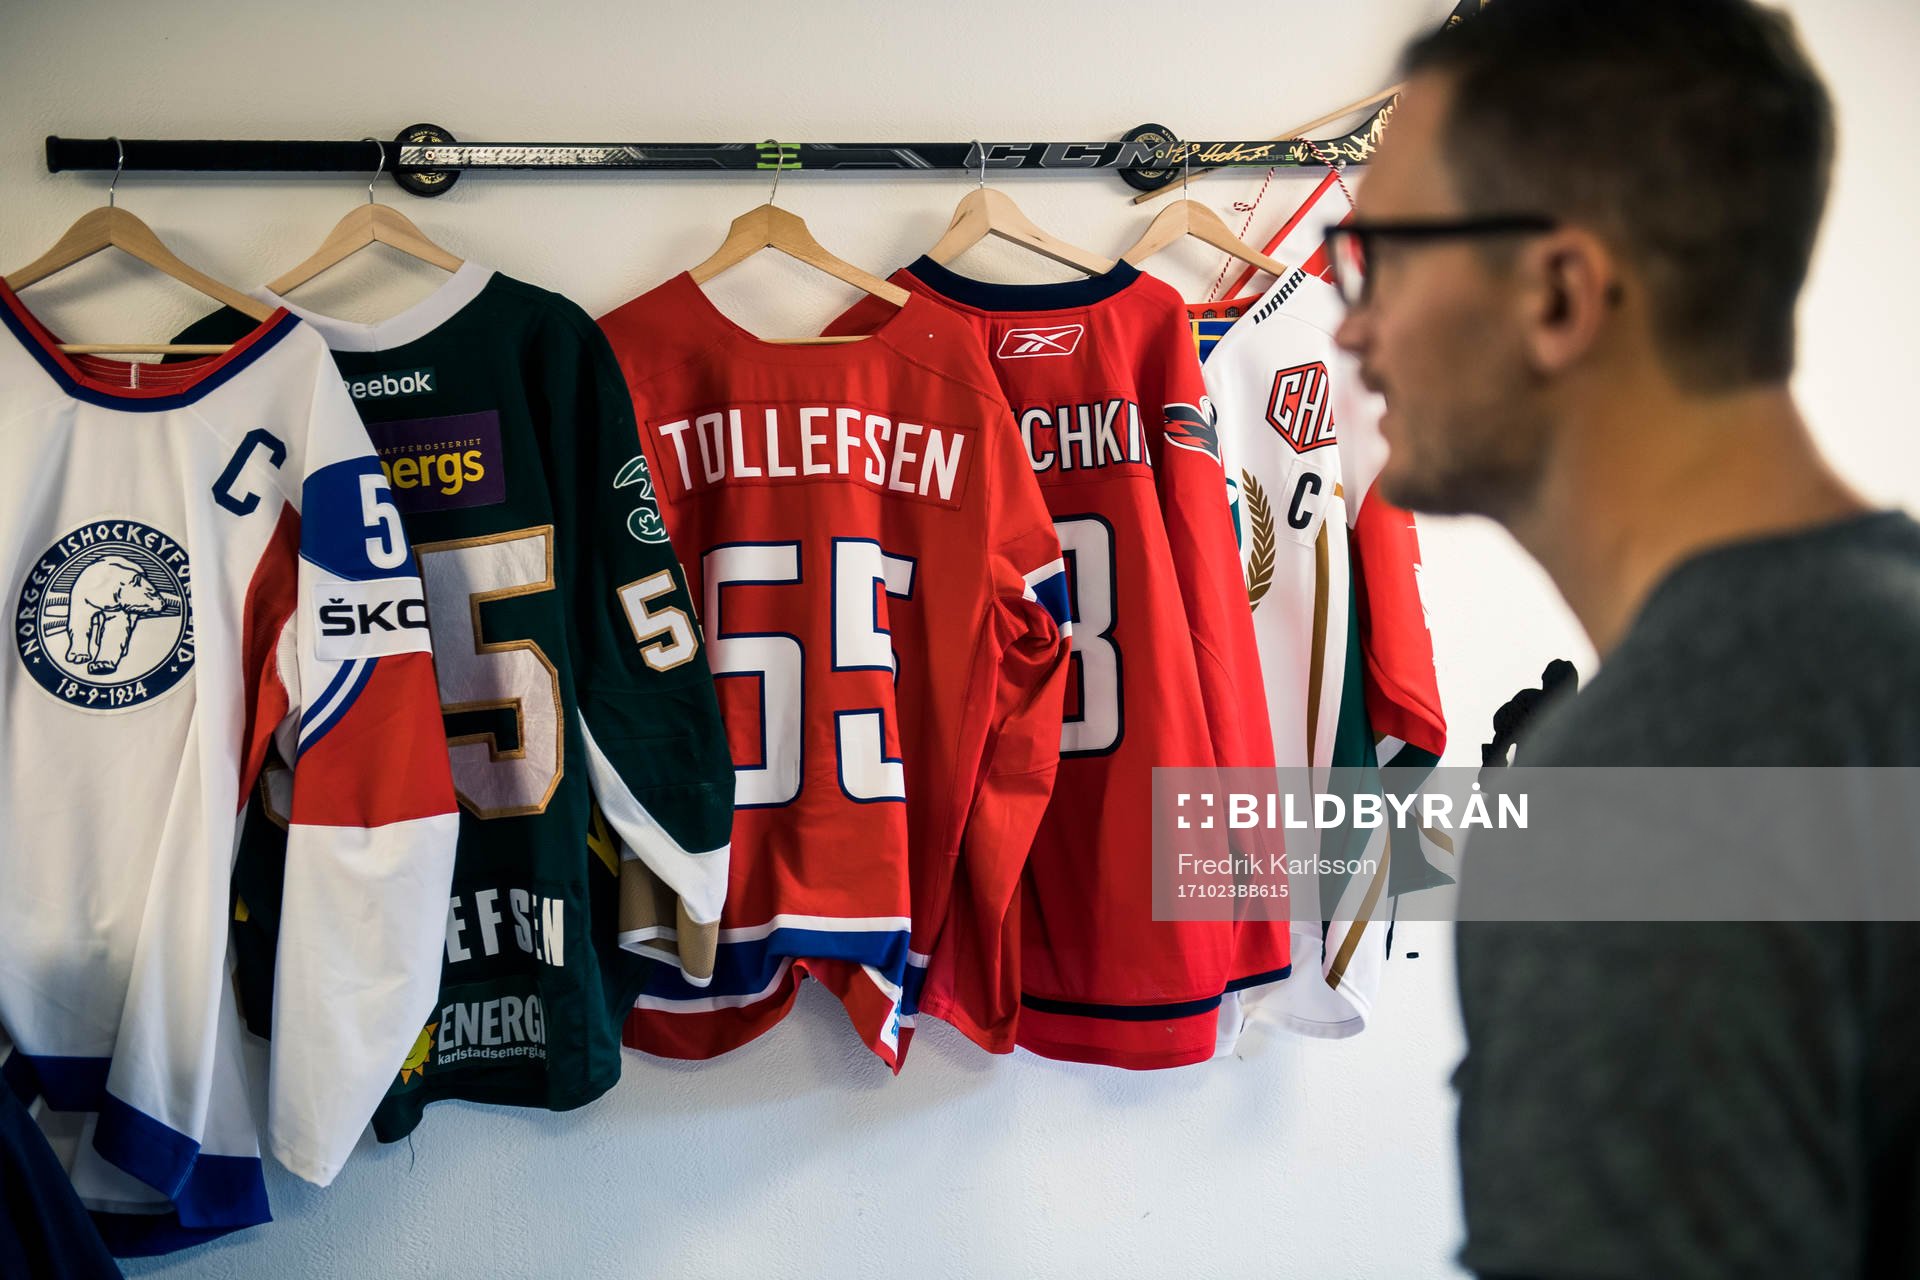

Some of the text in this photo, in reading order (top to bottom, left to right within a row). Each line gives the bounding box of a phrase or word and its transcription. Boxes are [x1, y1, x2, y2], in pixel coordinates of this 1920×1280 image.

[962, 142, 1178, 169] CCM
[1011, 397, 1153, 475] CHKI
[1271, 367, 1337, 446] CHL
[212, 427, 287, 516] C
[659, 407, 965, 501] TOLLEFSEN
[358, 473, 408, 570] 5
[1287, 471, 1322, 530] C
[18, 559, 57, 657] NORGES
[319, 598, 431, 637] ŠKO
[616, 568, 700, 673] 5
[55, 678, 148, 706] 18-9-1934
[411, 524, 565, 821] 5
[702, 536, 918, 811] 55
